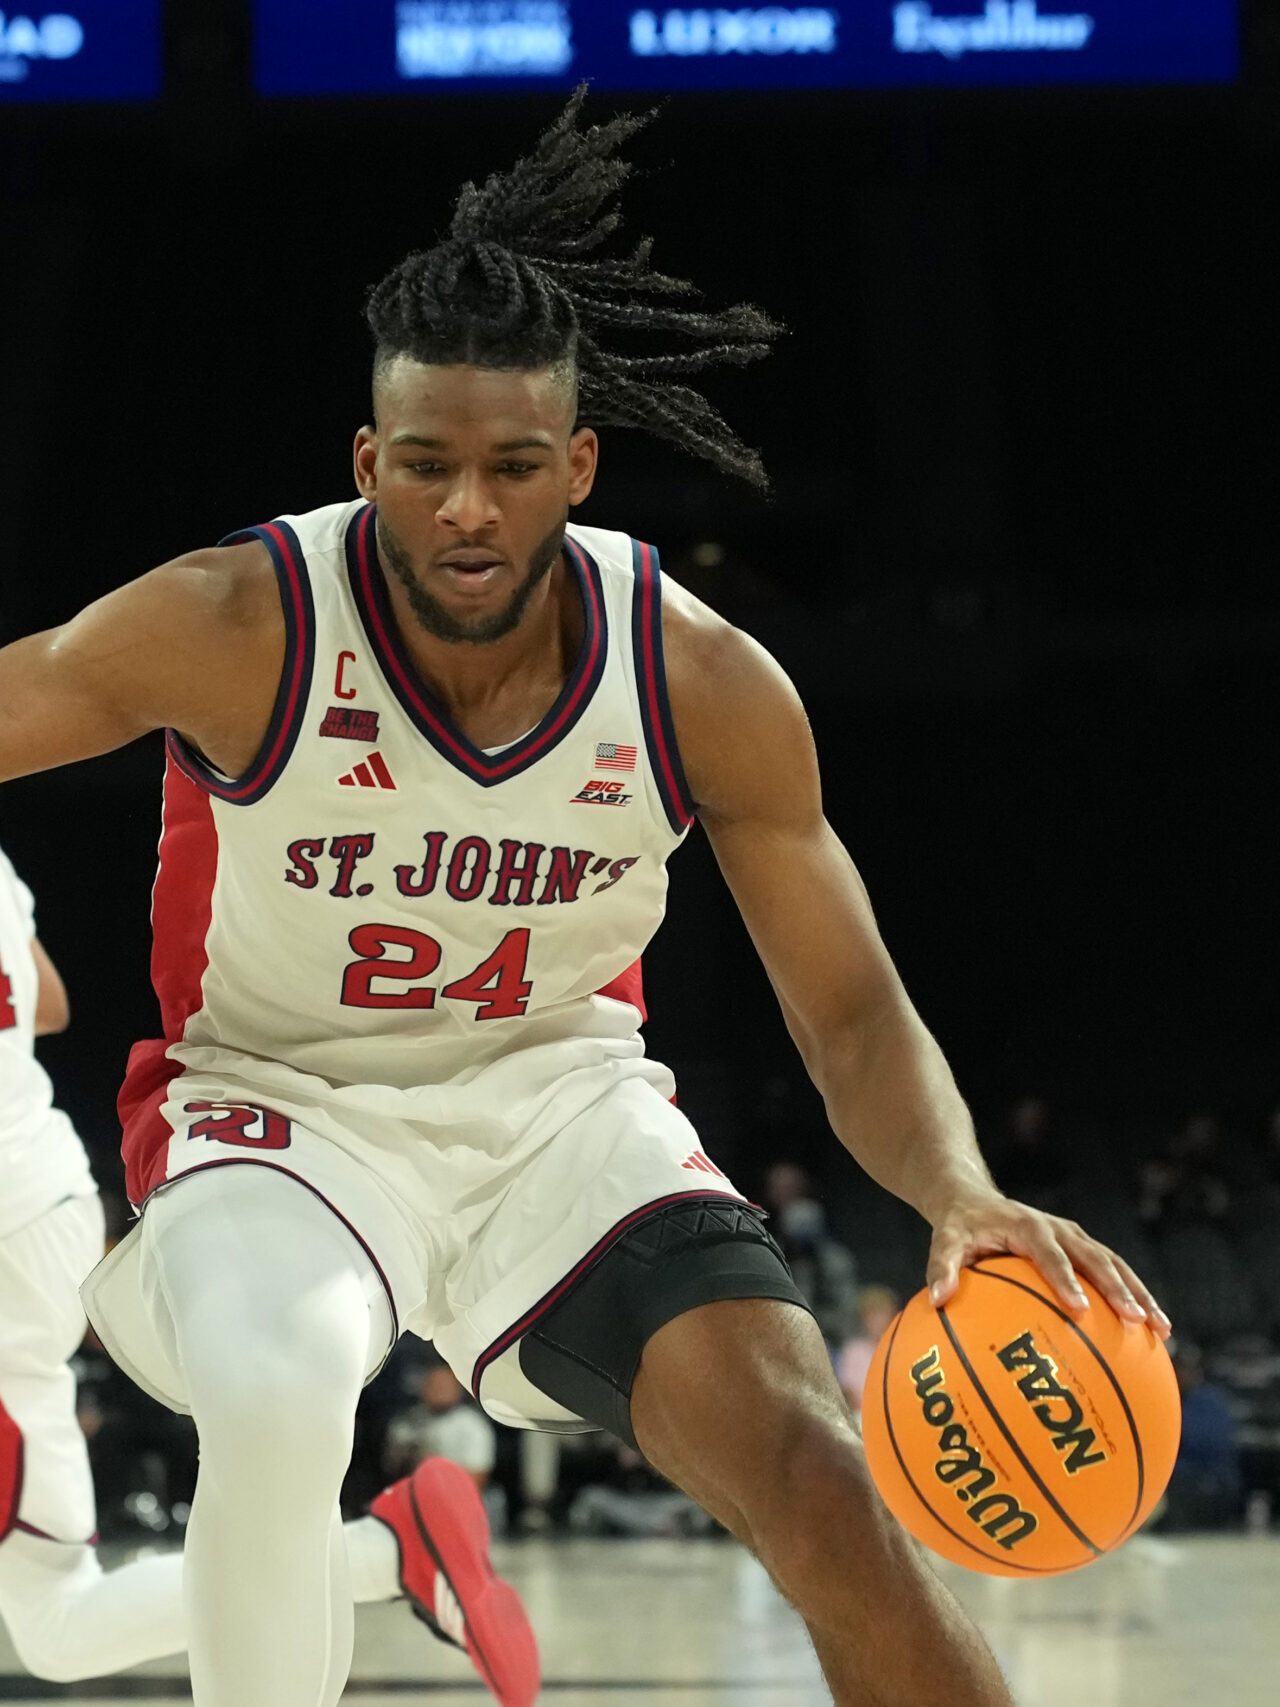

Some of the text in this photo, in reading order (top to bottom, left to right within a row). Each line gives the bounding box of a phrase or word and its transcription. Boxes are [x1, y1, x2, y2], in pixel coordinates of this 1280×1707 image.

[335, 650, 356, 700] C
[575, 791, 632, 805] EAST
[583, 780, 625, 794] BIG
[285, 831, 642, 906] ST. JOHN'S
[340, 923, 534, 1022] 24
[996, 1329, 1108, 1477] NCAA
[909, 1344, 1039, 1551] Wilson
